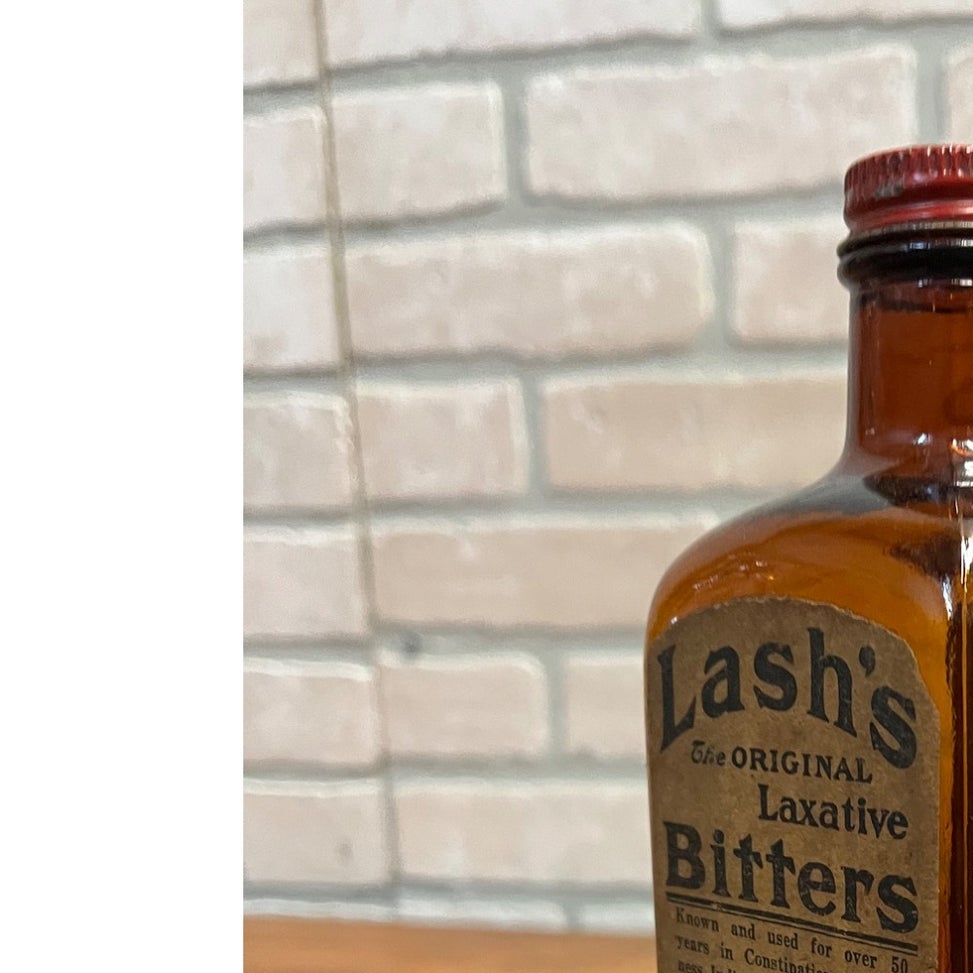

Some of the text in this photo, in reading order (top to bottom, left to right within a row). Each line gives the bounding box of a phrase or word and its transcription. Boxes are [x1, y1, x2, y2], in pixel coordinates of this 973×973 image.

[657, 627, 917, 769] Lash's
[691, 741, 873, 783] The ORIGINAL
[758, 784, 909, 839] Laxative
[663, 821, 919, 933] Bitters
[676, 907, 719, 932] Known
[731, 923, 756, 941] and
[767, 932, 798, 950] used
[811, 937, 832, 958] for
[844, 950, 877, 969] over
[676, 935, 710, 955] years
[719, 941, 734, 961] in
